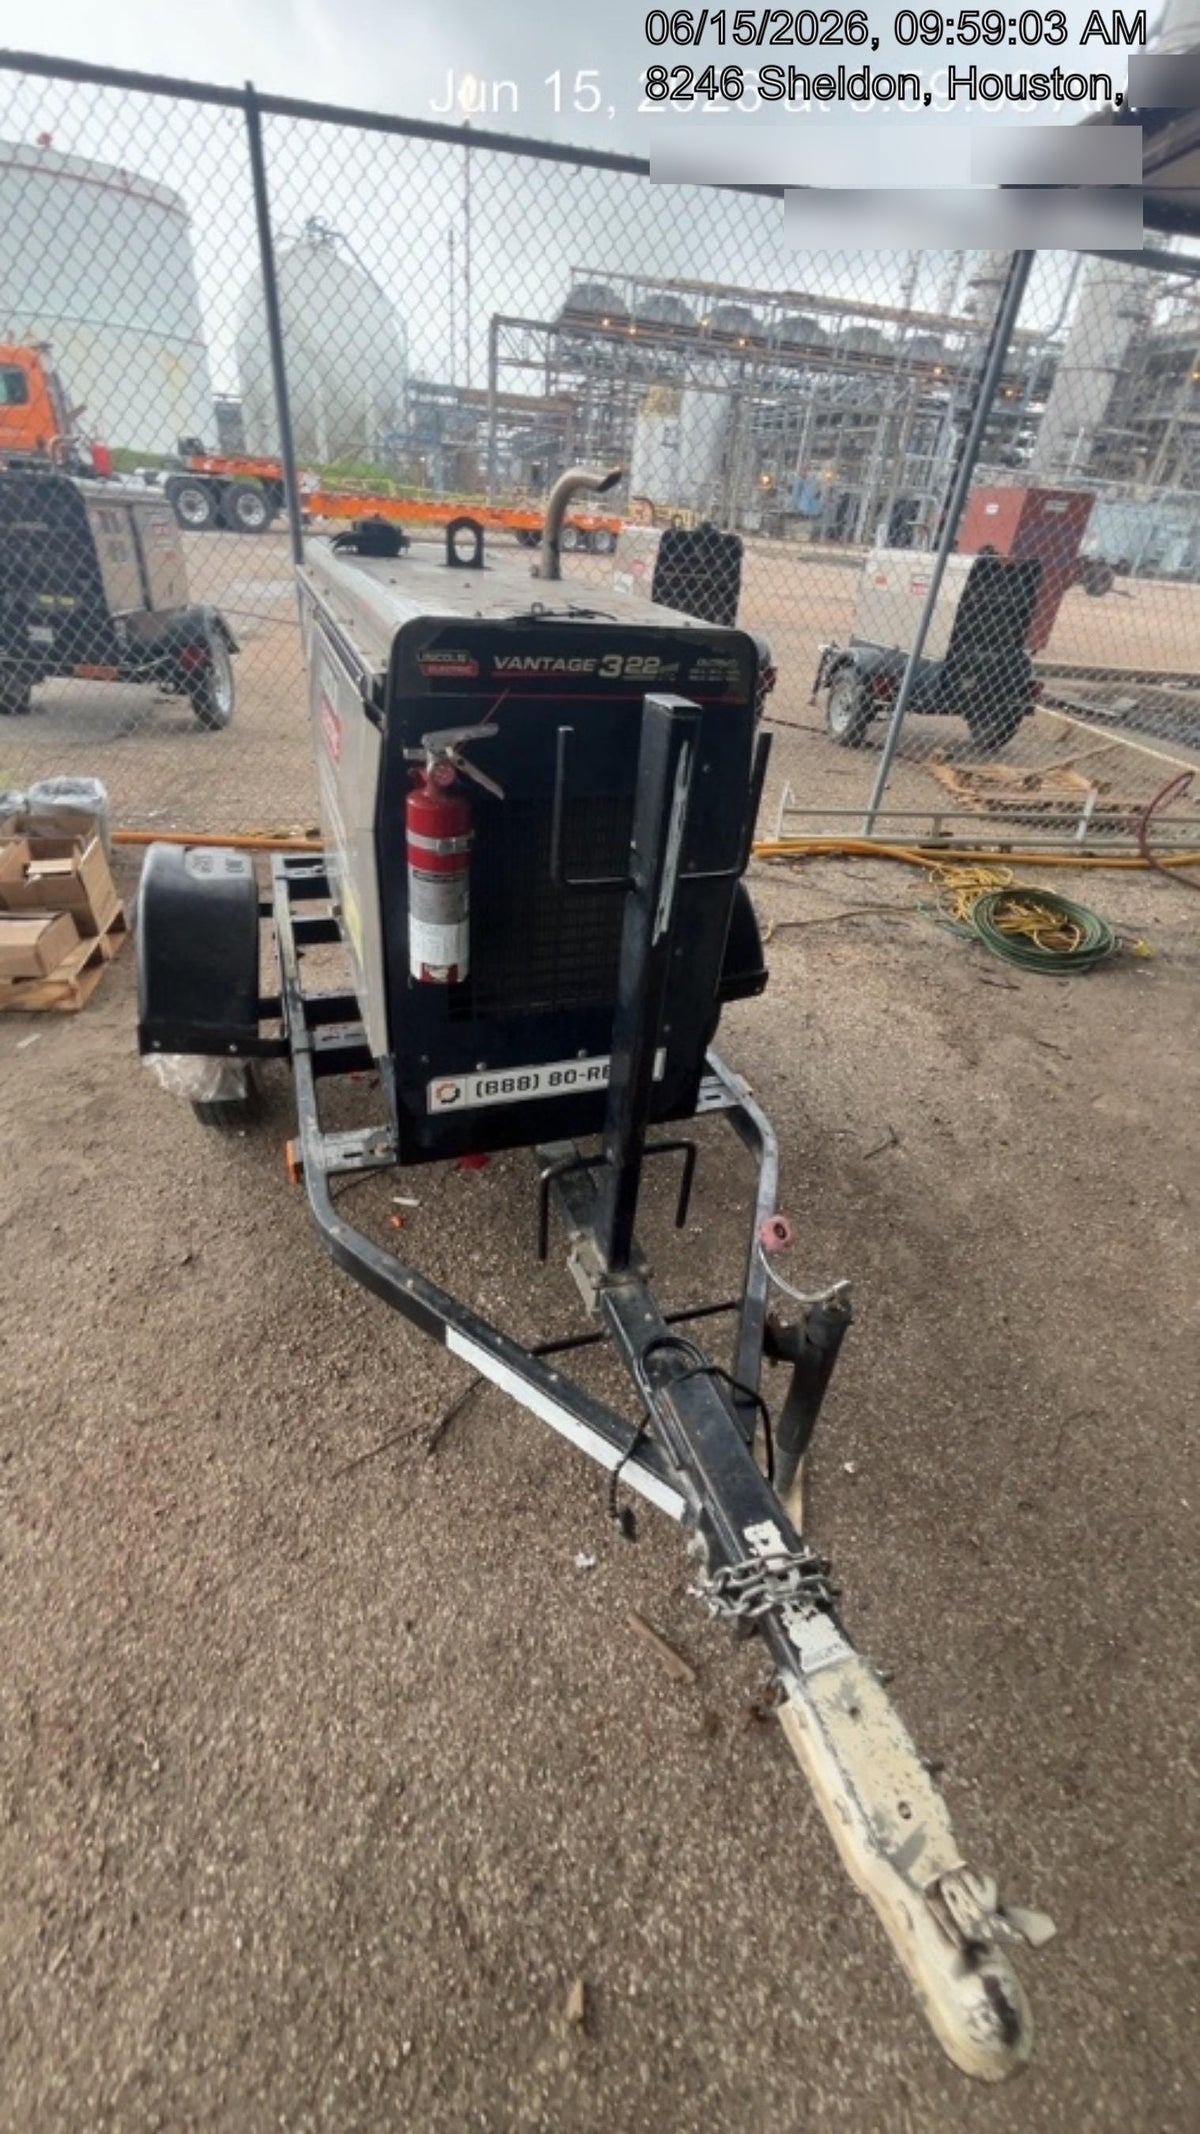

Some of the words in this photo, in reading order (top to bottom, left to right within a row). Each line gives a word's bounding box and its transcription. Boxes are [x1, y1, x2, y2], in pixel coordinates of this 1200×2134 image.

[493, 655, 597, 673] VANTAGE
[598, 653, 661, 678] 322
[476, 1073, 540, 1099] (888)
[549, 1062, 612, 1088] 80-RE
